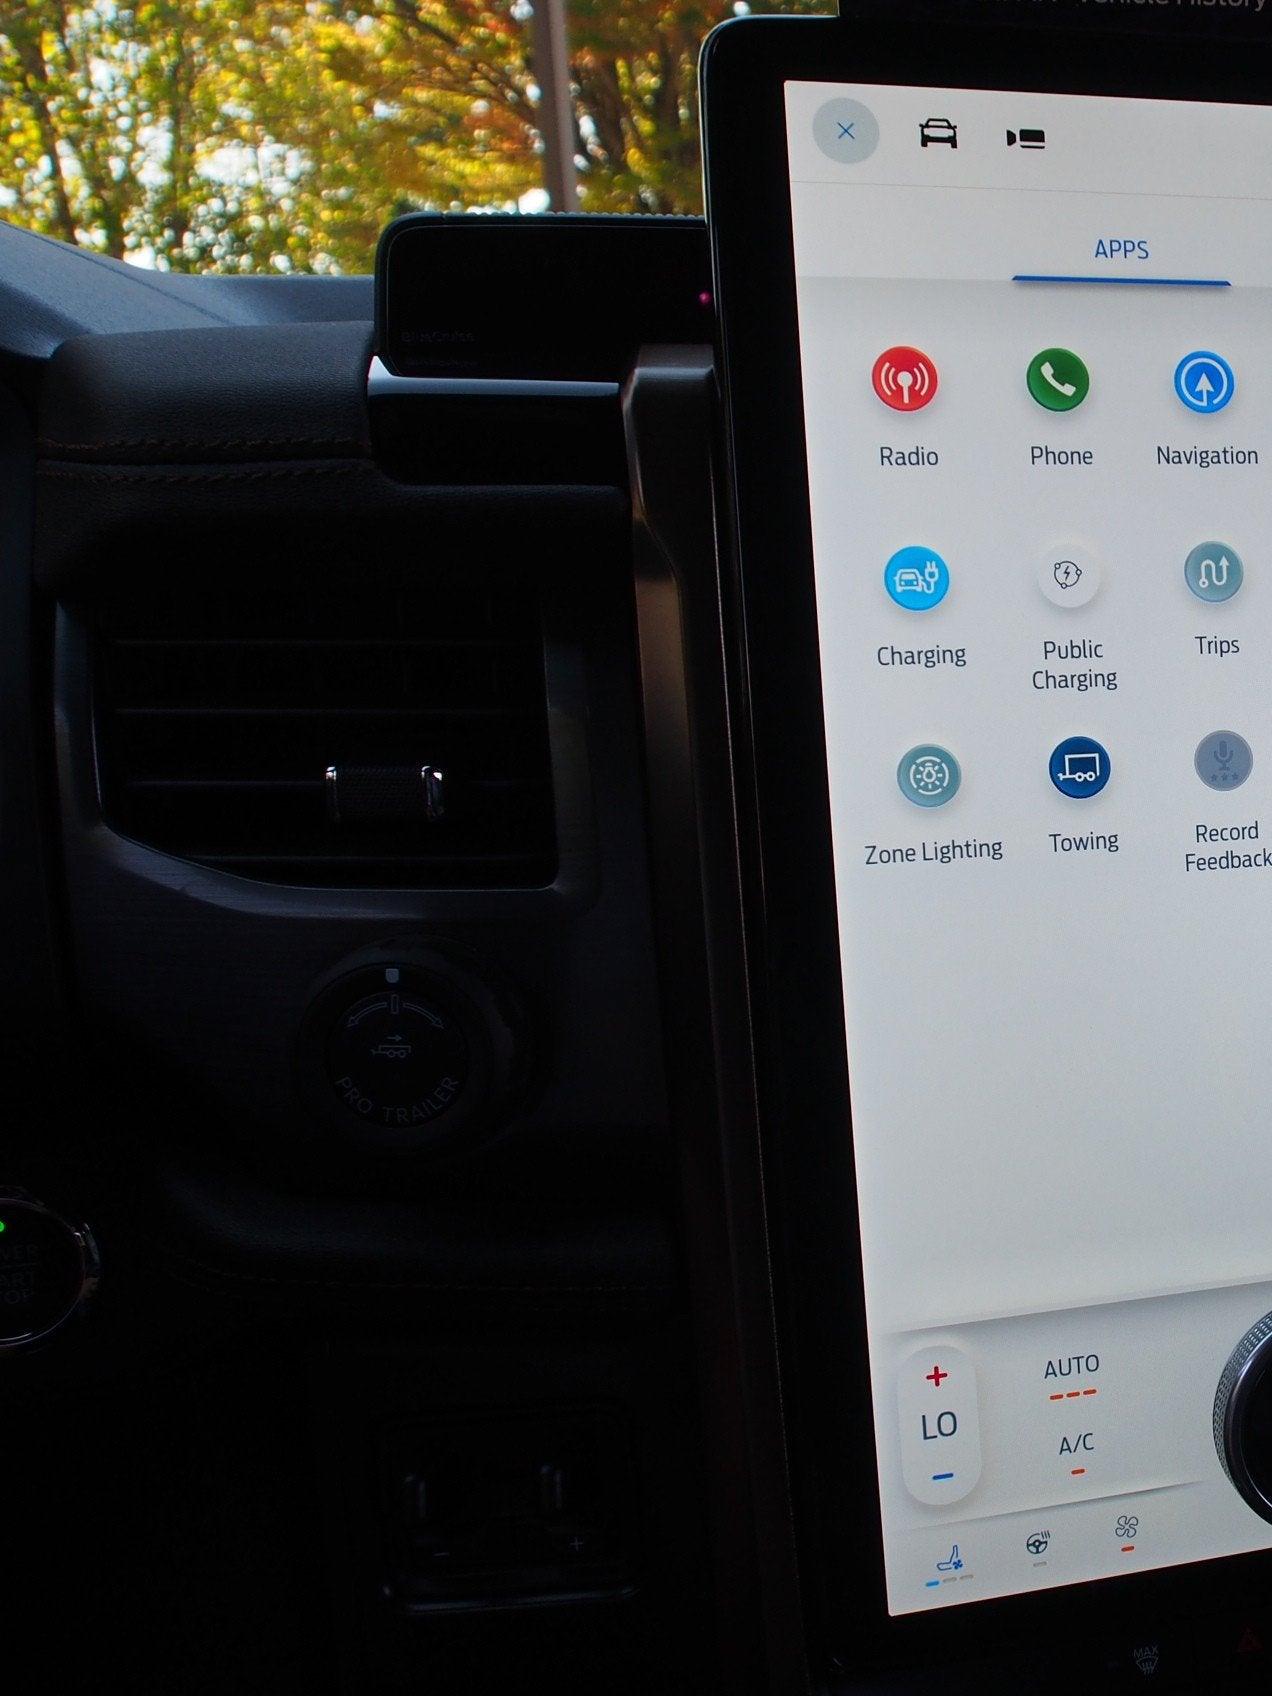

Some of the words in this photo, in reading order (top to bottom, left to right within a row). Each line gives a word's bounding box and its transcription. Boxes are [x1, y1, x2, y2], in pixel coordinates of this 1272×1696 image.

[1094, 238, 1150, 261] APPS
[879, 445, 939, 467] Radio
[1030, 445, 1094, 467] Phone
[1156, 444, 1259, 470] Navigation
[877, 643, 967, 670] Charging
[1043, 638, 1104, 661] Public
[1194, 634, 1241, 659] Trips
[1032, 667, 1118, 693] Charging
[1048, 831, 1120, 856] Towing
[1195, 820, 1260, 844] Record
[864, 844, 917, 866] Zone
[922, 837, 1004, 865] Lighting
[335, 1076, 374, 1113] PRO
[382, 1076, 459, 1123] TRAILER
[1043, 1353, 1101, 1378] AUTO
[920, 1410, 959, 1442] LO
[1058, 1431, 1095, 1456] A/C
[1133, 1645, 1160, 1660] MAX
